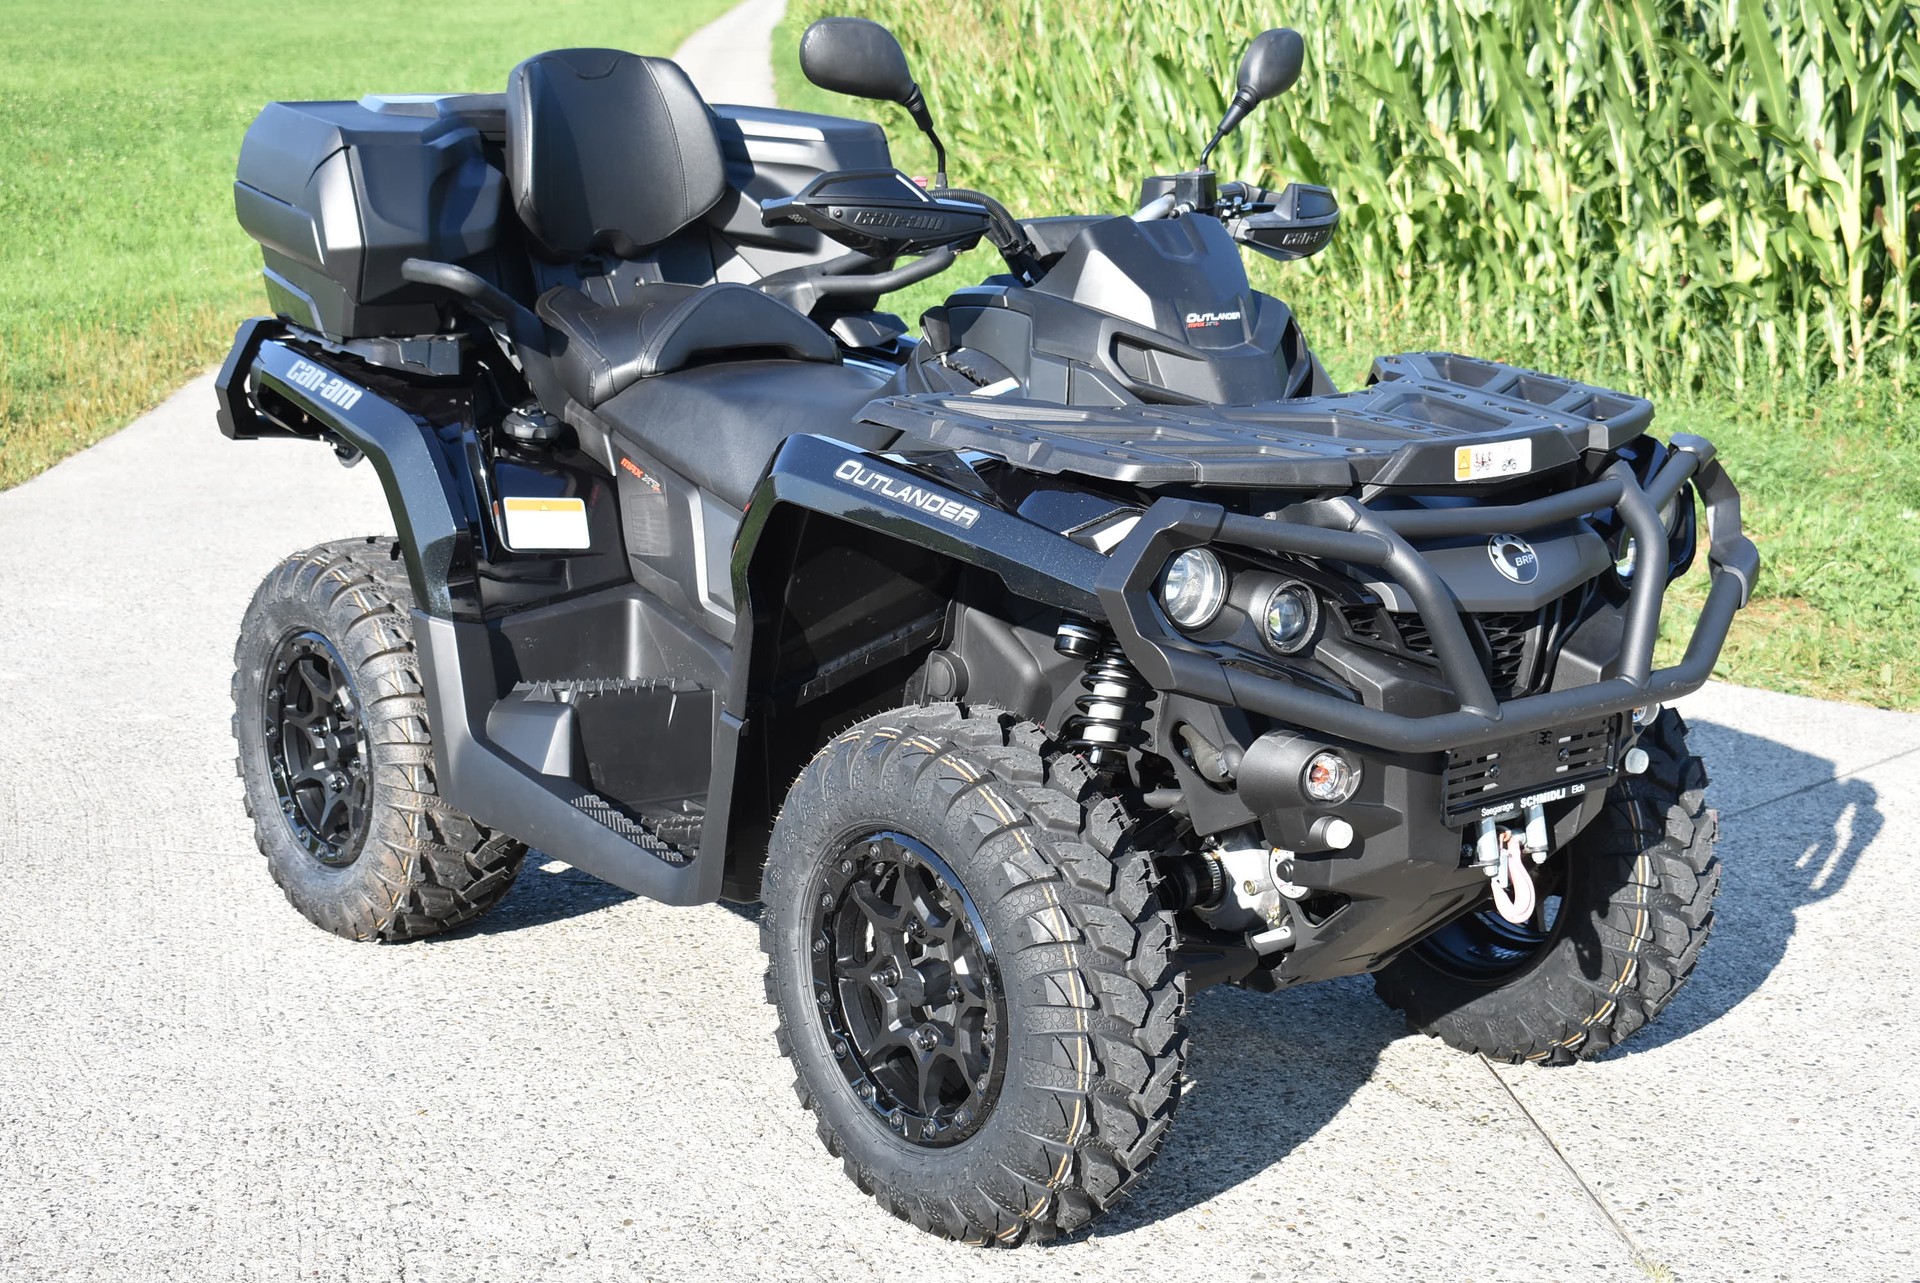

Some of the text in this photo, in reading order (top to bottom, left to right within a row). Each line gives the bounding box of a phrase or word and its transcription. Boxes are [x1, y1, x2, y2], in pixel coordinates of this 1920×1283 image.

[286, 360, 363, 411] can-am
[834, 460, 980, 527] OUTLANDER
[1515, 554, 1534, 567] BRP
[1481, 783, 1586, 817] Seegarage SCHMIDLI Eich
